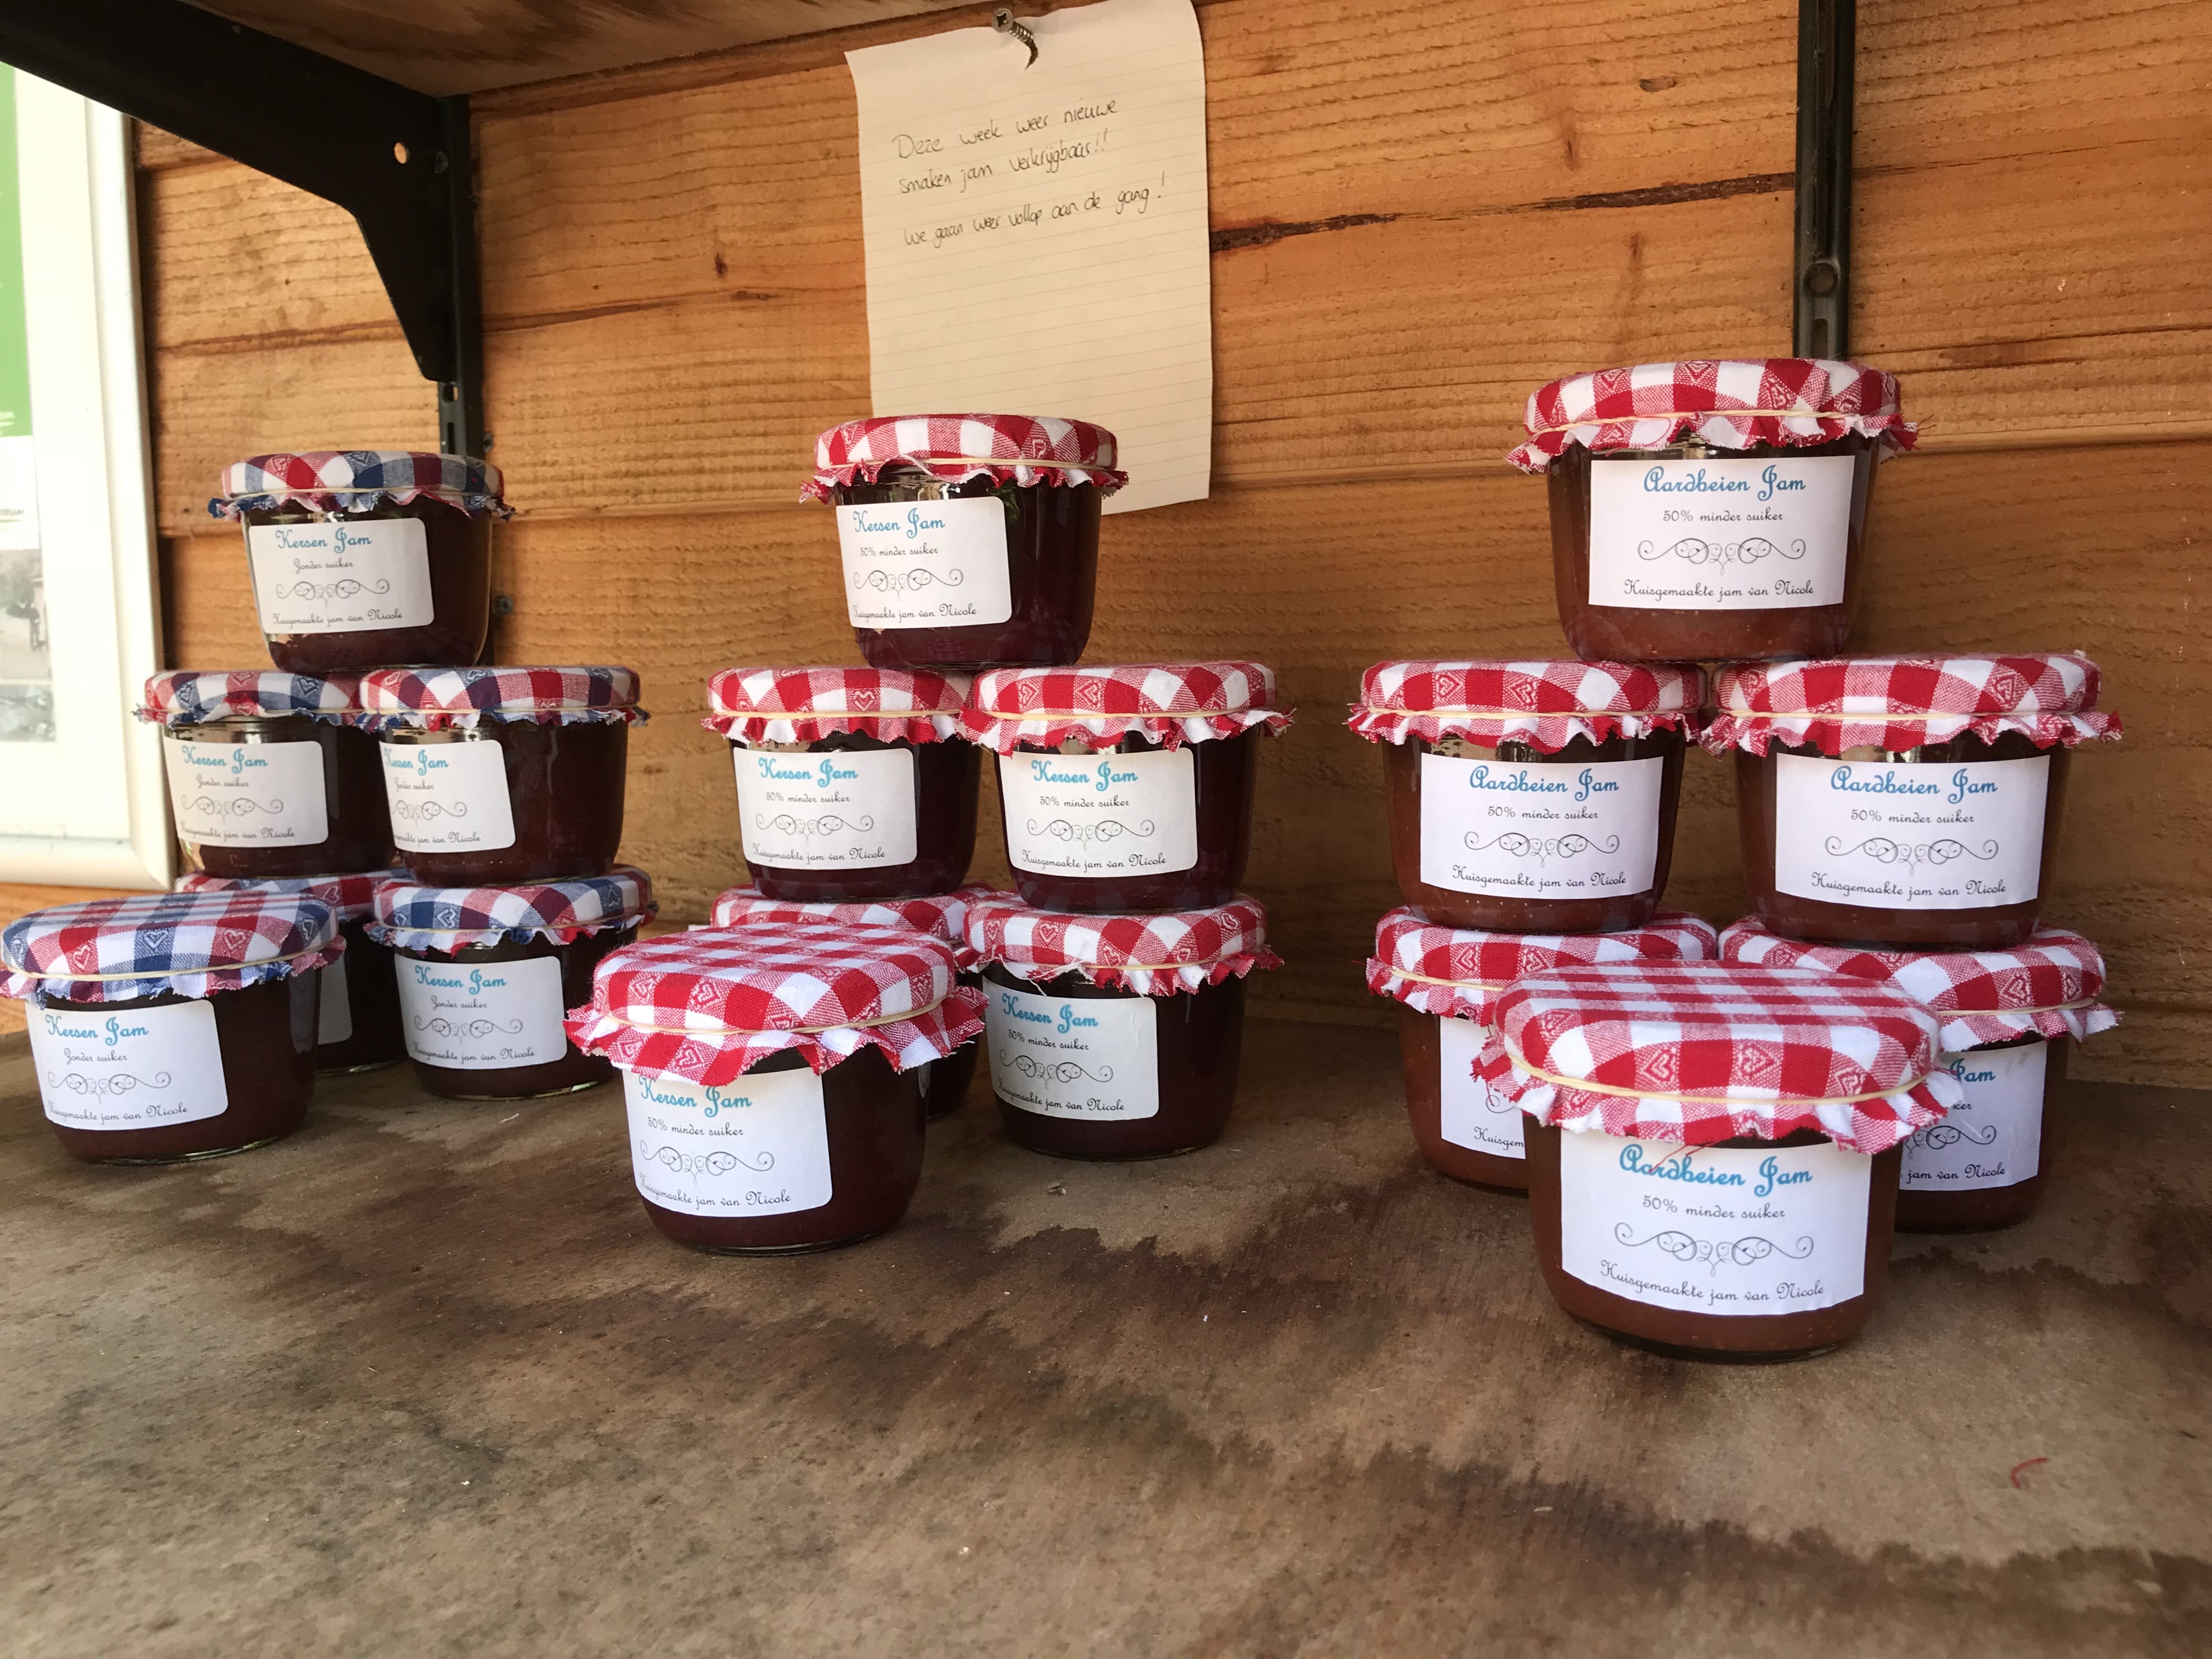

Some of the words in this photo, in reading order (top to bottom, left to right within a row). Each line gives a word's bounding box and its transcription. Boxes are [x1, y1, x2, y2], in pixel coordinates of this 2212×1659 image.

[892, 134, 943, 159] Deze
[960, 119, 1002, 145] week
[1016, 115, 1048, 133] weer
[1064, 97, 1118, 122] nieuwe
[899, 170, 951, 193] smaken
[935, 223, 964, 248] gaan
[973, 215, 1000, 233] weer
[1085, 192, 1101, 210] de
[1644, 466, 1751, 492] Aardbeien
[1757, 465, 1806, 501] Jam
[853, 510, 901, 532] Kersen
[906, 507, 945, 538] Jam
[1663, 510, 1693, 522] 50%
[1700, 510, 1742, 522] minder
[1746, 507, 1784, 521] suiker
[275, 530, 328, 549] Kersen
[334, 527, 372, 554] Jam
[860, 547, 876, 556] 50%
[879, 546, 906, 556] minder
[910, 543, 939, 555] suiker
[293, 558, 322, 574] Zonder
[325, 558, 354, 568] suiker
[1624, 579, 1714, 602] Huisgemaakte
[1717, 586, 1742, 602] jam
[1748, 588, 1769, 596] van
[1775, 579, 1814, 595] Nicole
[327, 616, 343, 627] jam
[368, 608, 403, 620] Nicole
[853, 605, 896, 623] Huisgemaakte
[899, 611, 915, 623] jam
[939, 603, 977, 616] Nicole
[182, 745, 226, 766] Kersen
[232, 748, 268, 774] Jam
[417, 749, 449, 776] Jam
[196, 774, 221, 788] Zonder
[224, 777, 249, 787] suiker
[758, 757, 812, 780] Kersen
[817, 759, 859, 788] Jam
[1031, 760, 1090, 783] Kersen
[1095, 761, 1138, 791] Jam
[1469, 765, 1568, 793] Aardbeien
[1575, 768, 1620, 802] Jam
[413, 780, 435, 789] suiker
[1831, 765, 1940, 795] Aardbeien
[1948, 768, 1998, 804] Jam
[766, 792, 784, 801] 50%
[788, 794, 817, 803] minder
[820, 792, 851, 803] suiker
[1040, 796, 1059, 806] 50%
[1064, 798, 1095, 808] minder
[1098, 795, 1130, 807] suiker
[1487, 806, 1516, 818] 50%
[1522, 809, 1560, 819] minder
[1564, 806, 1599, 819] suiker
[1850, 809, 1882, 821] 50%
[1888, 811, 1931, 823] minder
[1936, 810, 1975, 823] suiker
[224, 831, 239, 842] jam
[261, 827, 295, 838] Nicole
[418, 837, 430, 847] jam
[448, 831, 481, 843] Nicole
[753, 843, 804, 862] Huisgemaakte
[806, 854, 824, 865] jam
[849, 847, 885, 859] Nicole
[1023, 850, 1081, 870] Huisgemaakte
[1084, 861, 1103, 873] jam
[1128, 853, 1167, 866] Nicole
[1452, 865, 1536, 888] Huisgemaakte
[1538, 878, 1561, 891] jam
[1566, 878, 1585, 887] van
[1590, 872, 1626, 887] Nicole
[1811, 872, 1903, 897] Huisgemaakte
[1906, 885, 1933, 901] jam
[1938, 887, 1960, 895] van
[1965, 879, 2006, 895] Nicole
[415, 964, 464, 988] Kersen
[469, 968, 506, 995] Jam
[431, 995, 458, 1010] Zonder
[1002, 992, 1052, 1024] Kersen
[1057, 1005, 1098, 1033] Jam
[45, 1014, 98, 1038] Kersen
[105, 1017, 149, 1046] Jam
[1008, 1029, 1025, 1042] 50%
[1028, 1037, 1056, 1048] minder
[1059, 1038, 1089, 1050] suiker
[64, 1047, 93, 1064] Zonder
[97, 1050, 128, 1062] suiker
[461, 1053, 477, 1064] jam
[500, 1047, 534, 1059] Nicole
[1950, 1058, 1996, 1082] Jam
[639, 1076, 697, 1108] Kersen
[704, 1086, 753, 1118] Jam
[1045, 1098, 1062, 1110] jam
[1065, 1102, 1083, 1110] van
[1087, 1098, 1125, 1111] Nicole
[101, 1112, 120, 1125] jam
[145, 1102, 188, 1118] Nicole
[648, 1116, 667, 1131] 50%
[672, 1125, 704, 1135] minder
[708, 1122, 744, 1136] suiker
[1474, 1126, 1525, 1150] Huisgem
[1620, 1143, 1746, 1186] Aardbeien
[1753, 1156, 1812, 1197] Jam
[1906, 1169, 1932, 1184] jam
[1964, 1163, 2005, 1178] Nicole
[640, 1172, 693, 1204] Huisgemaakte
[696, 1197, 716, 1210] jam
[746, 1189, 792, 1205] Nicole
[1642, 1195, 1678, 1213] 50%
[1685, 1205, 1735, 1218] minder
[1741, 1203, 1785, 1218] suiker
[1600, 1259, 1705, 1299] Huisgemaakte
[1708, 1288, 1739, 1306] jam
[1744, 1290, 1769, 1301] van
[1776, 1279, 1825, 1300] Nicole
